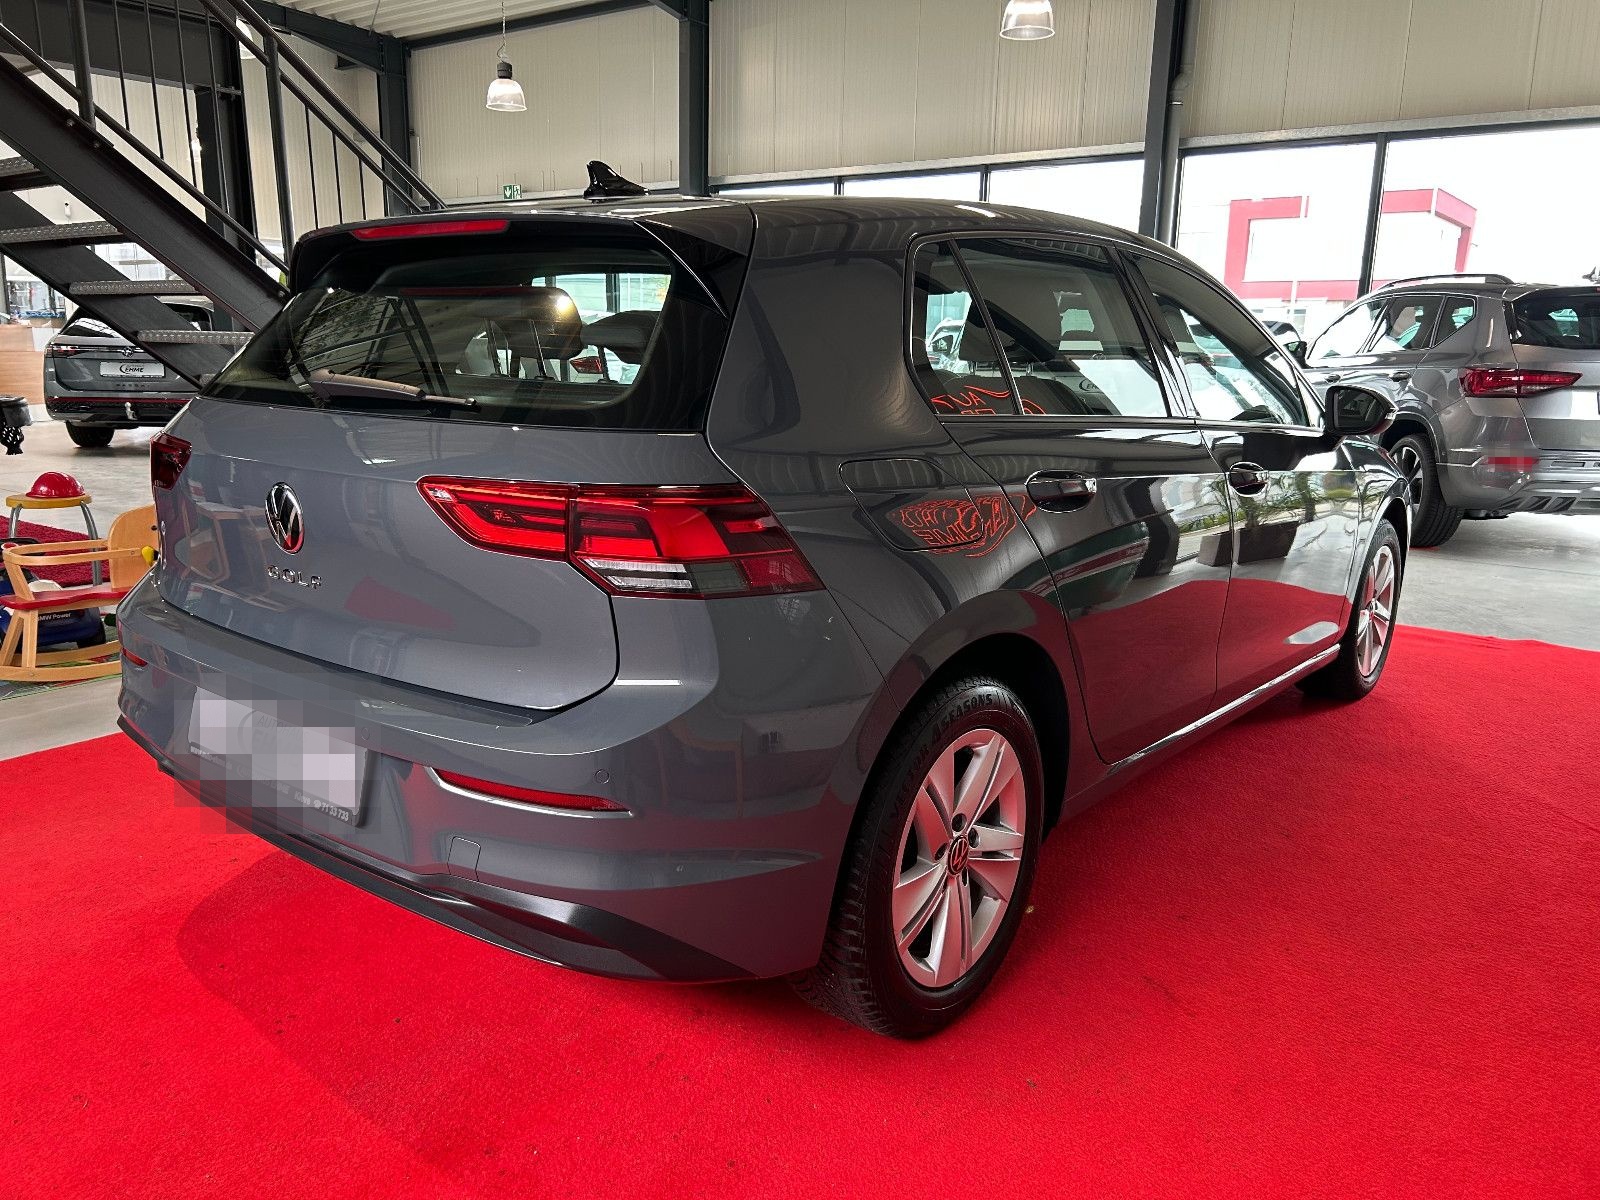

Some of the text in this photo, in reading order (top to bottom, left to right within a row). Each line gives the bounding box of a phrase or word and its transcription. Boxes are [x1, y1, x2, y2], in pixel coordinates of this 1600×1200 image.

[267, 564, 322, 590] GOLF
[52, 612, 71, 620] Power
[337, 809, 349, 821] 733
